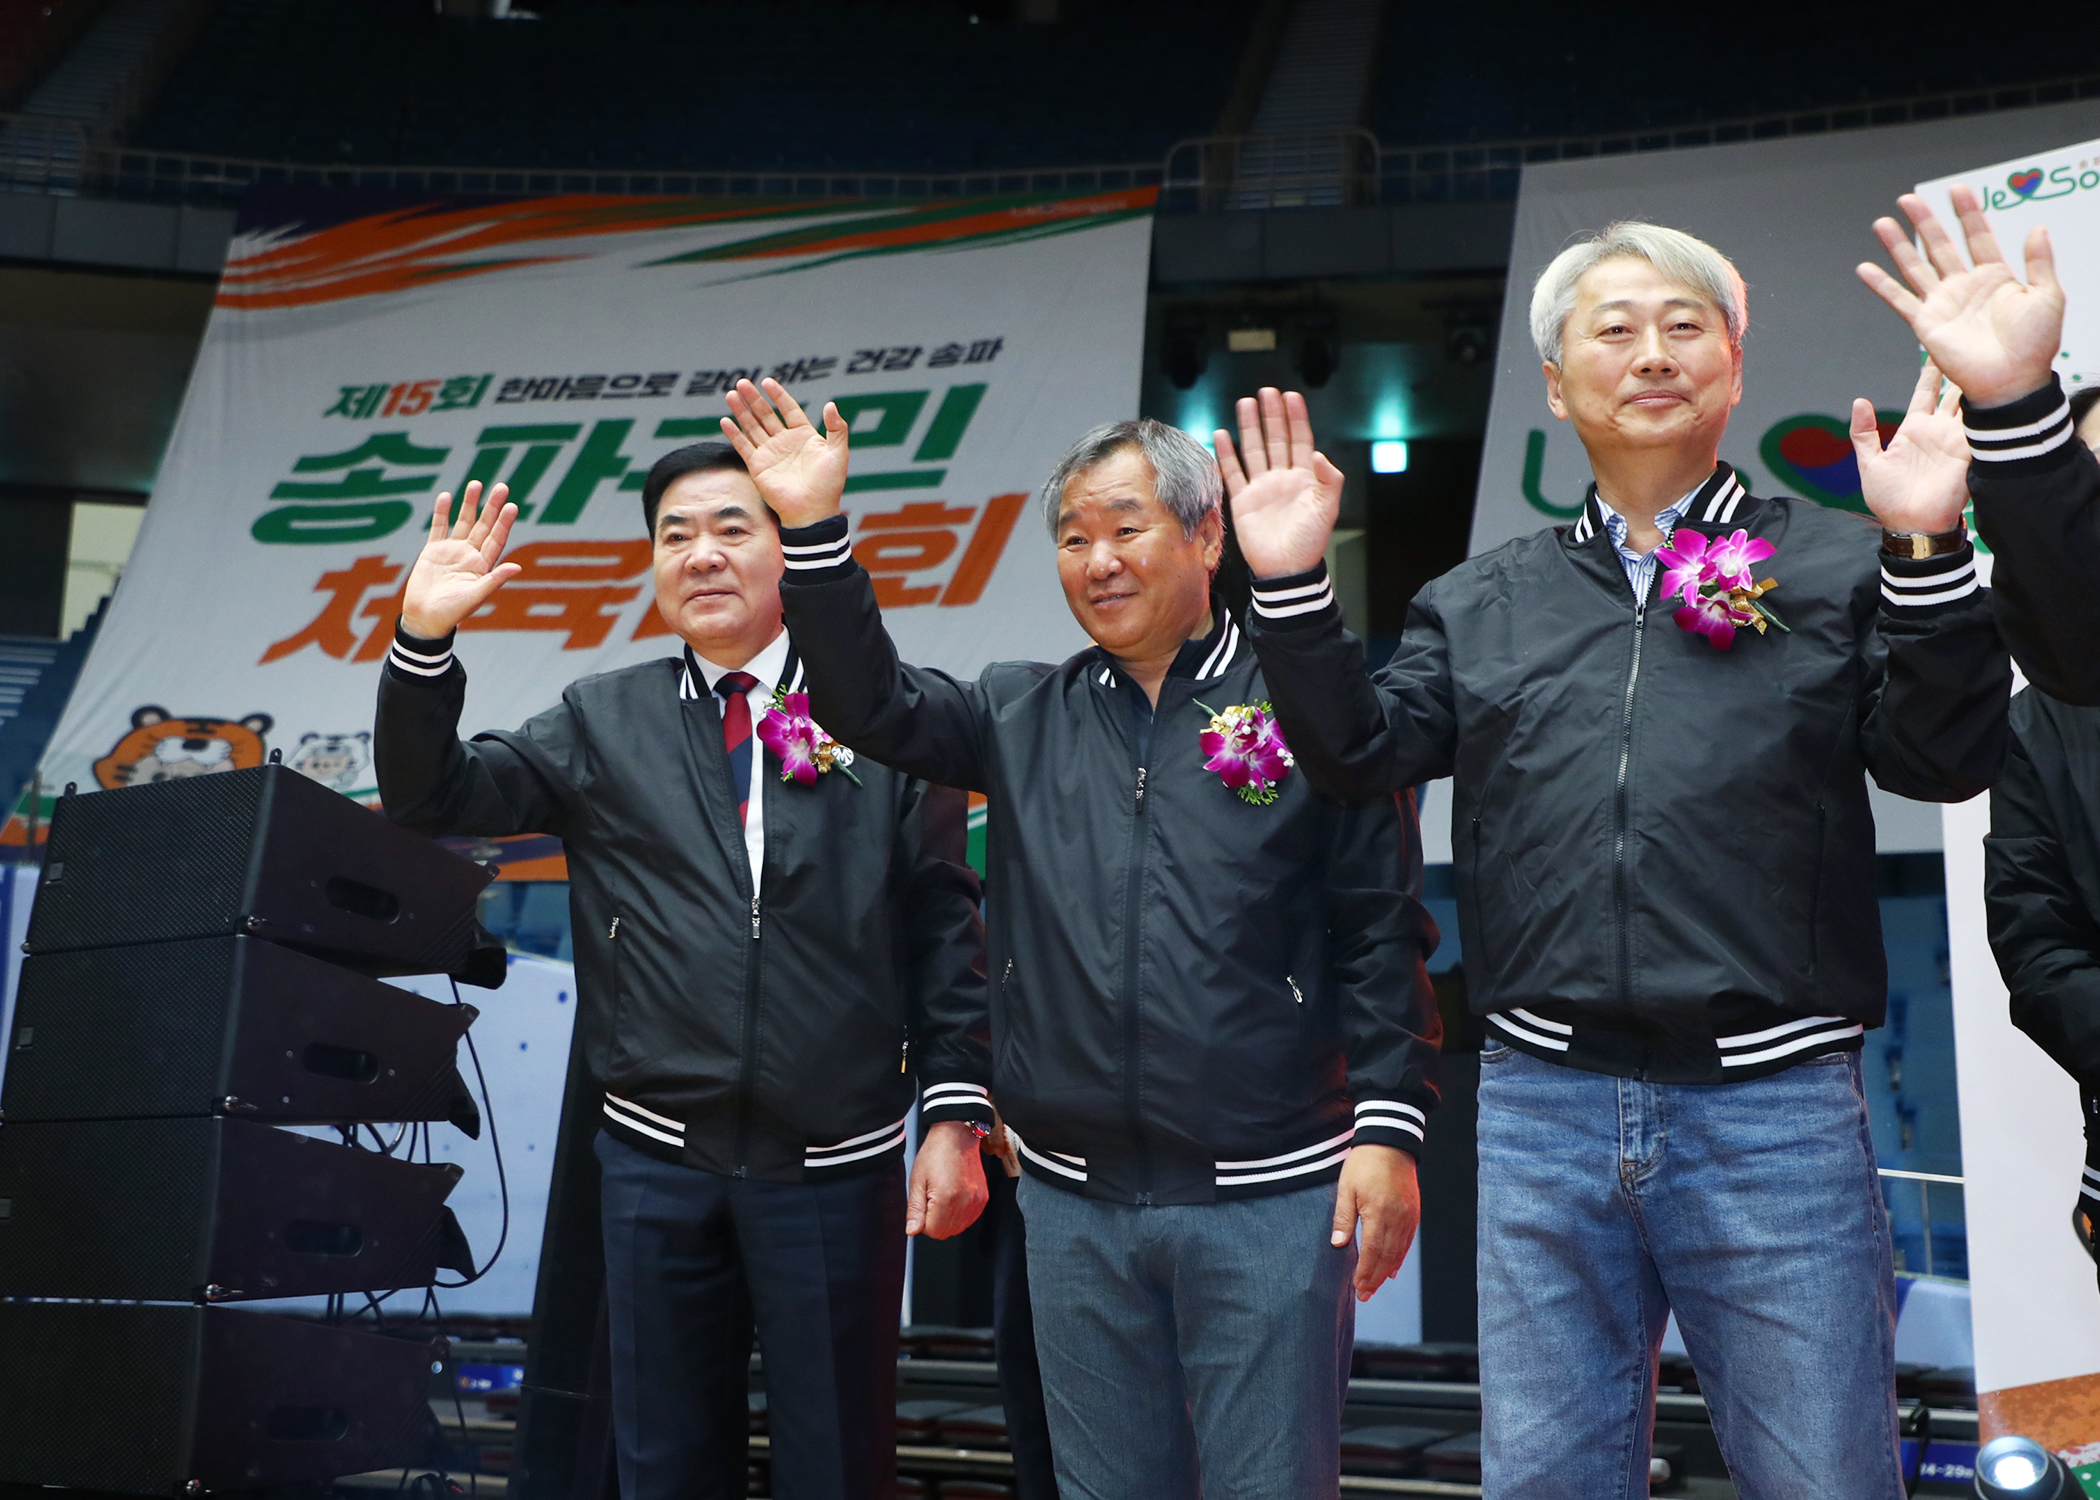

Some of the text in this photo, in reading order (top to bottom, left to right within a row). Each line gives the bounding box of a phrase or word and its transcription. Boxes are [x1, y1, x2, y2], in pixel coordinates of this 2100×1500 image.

[322, 373, 496, 420] 제15회
[494, 372, 682, 405] 한마음으로
[845, 346, 924, 375] 건강
[927, 335, 1005, 369] 송파
